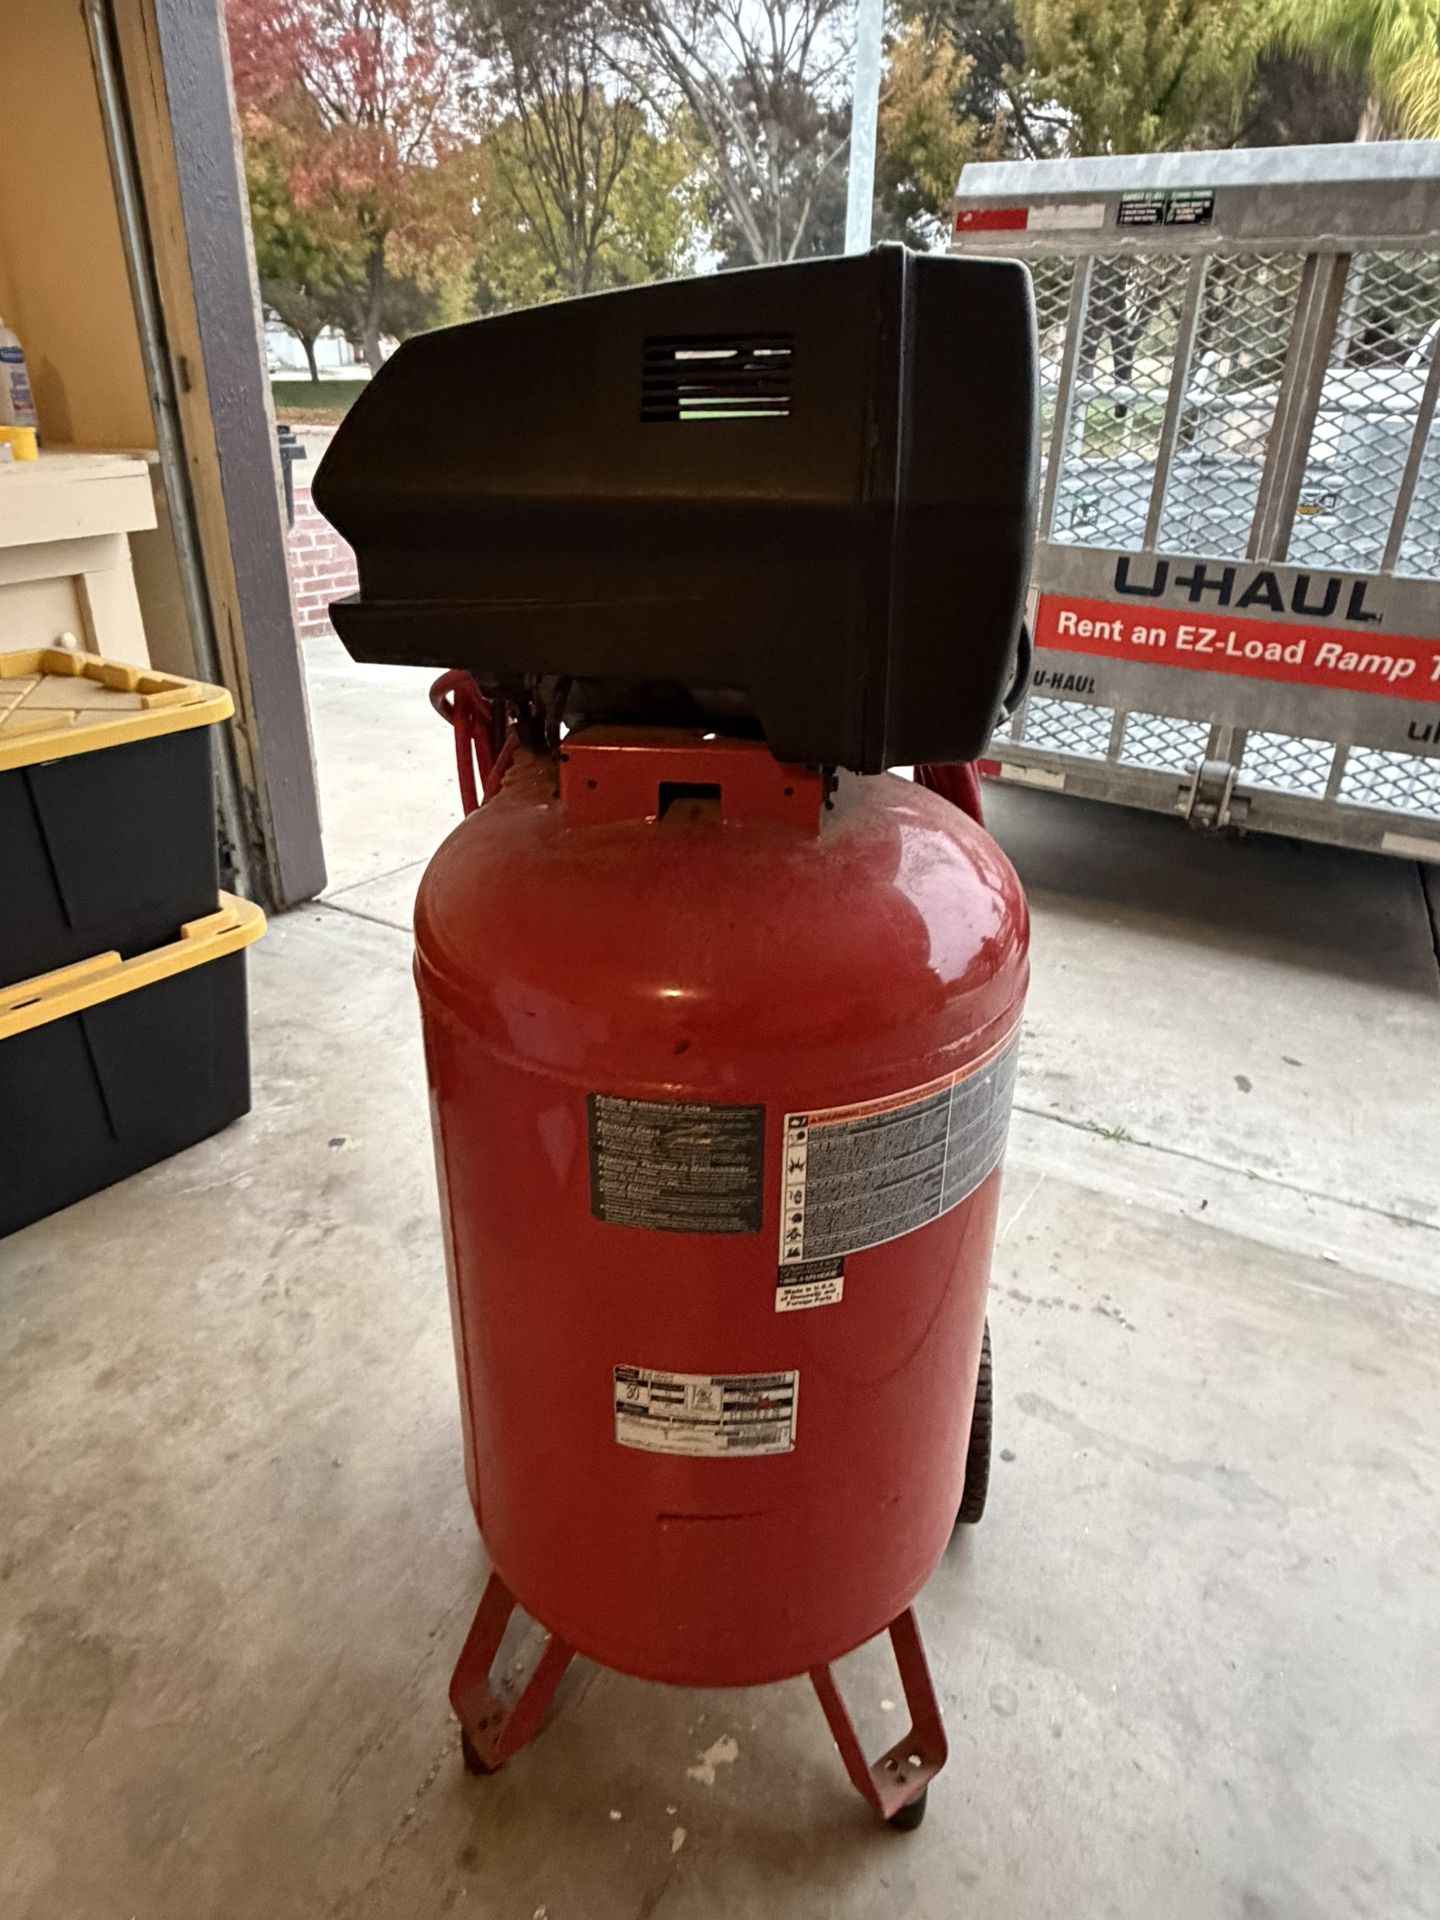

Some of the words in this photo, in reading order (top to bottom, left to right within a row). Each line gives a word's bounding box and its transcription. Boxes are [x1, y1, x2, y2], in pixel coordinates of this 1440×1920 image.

[1113, 556, 1383, 623] U-HAUL
[1057, 611, 1124, 642] Rent
[1131, 623, 1167, 647] an
[1175, 624, 1307, 665] EZ-Load
[1314, 641, 1417, 683] Ramp
[1033, 669, 1096, 695] U-HAUL
